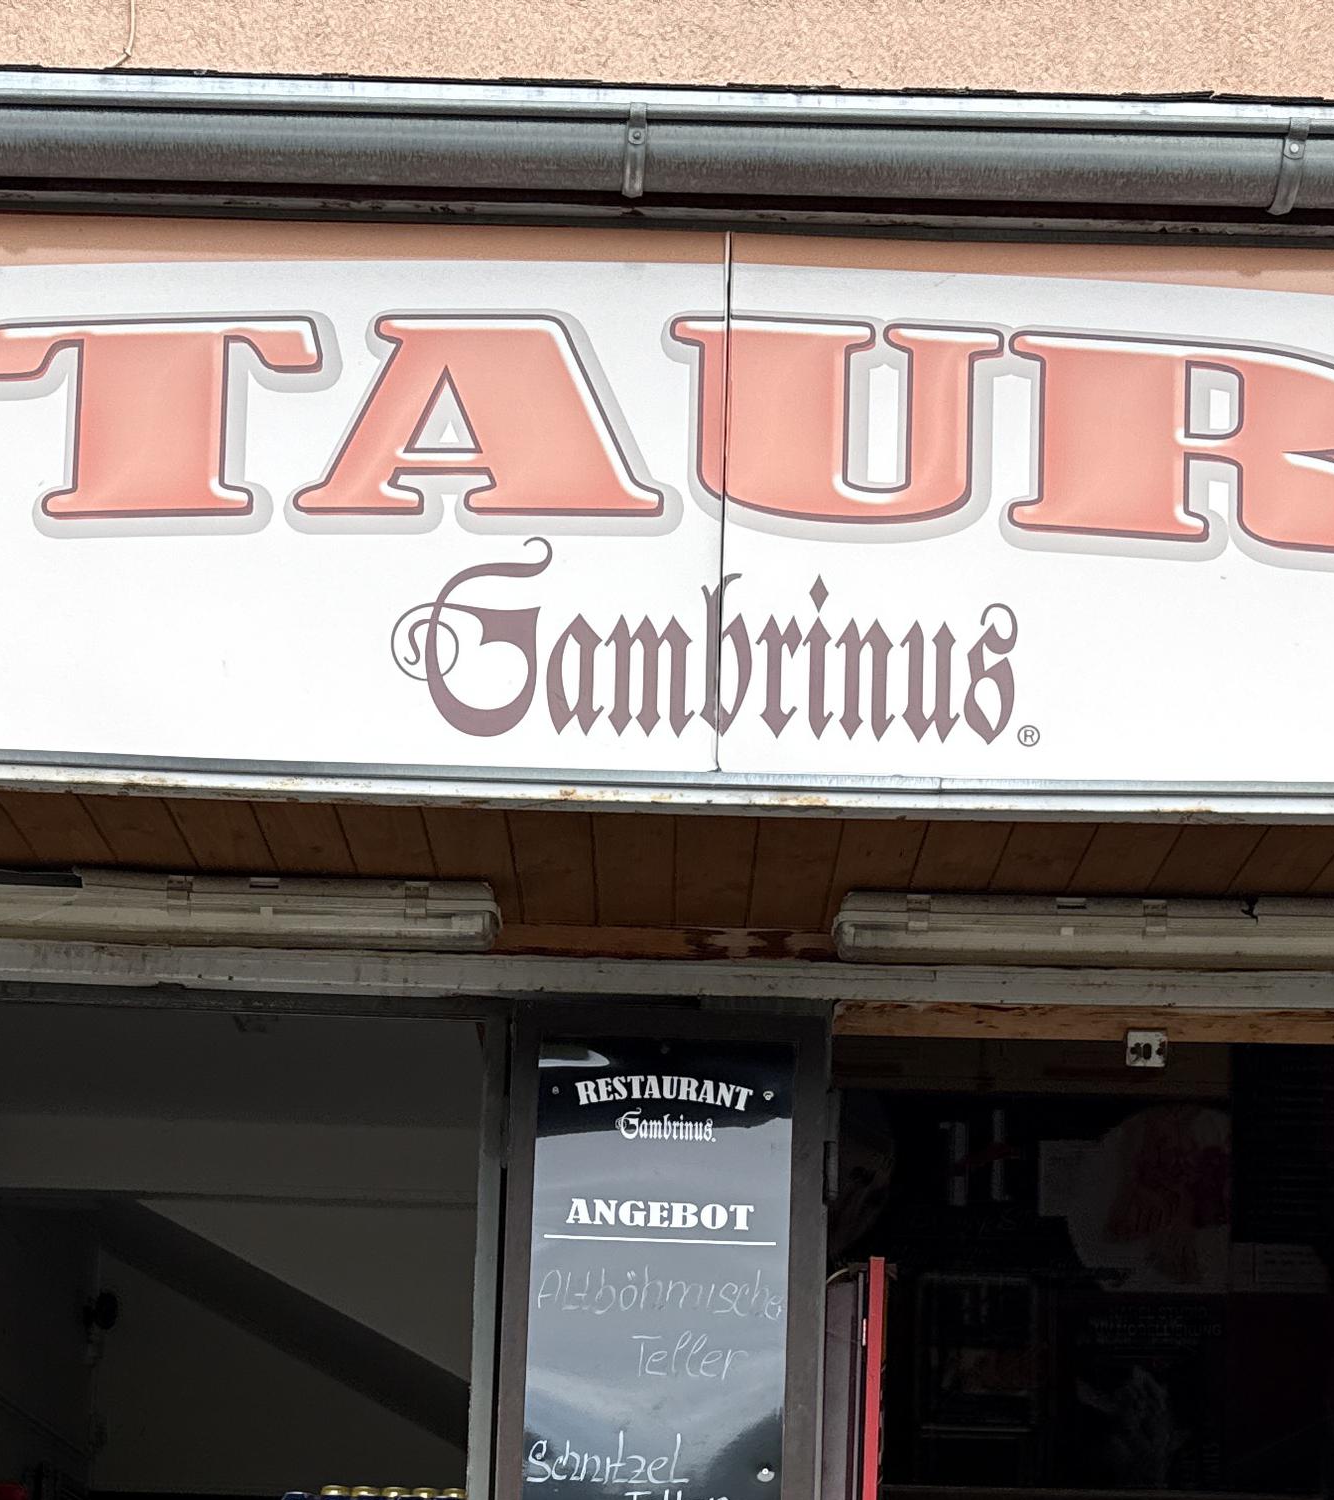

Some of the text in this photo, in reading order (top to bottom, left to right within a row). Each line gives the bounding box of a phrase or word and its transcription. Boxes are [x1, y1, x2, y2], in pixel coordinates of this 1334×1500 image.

[575, 1075, 753, 1111] RESTAURANT
[566, 1198, 754, 1231] ANGEBOT
[632, 1331, 748, 1380] Teller
[526, 1430, 689, 1485] Schnitzel
